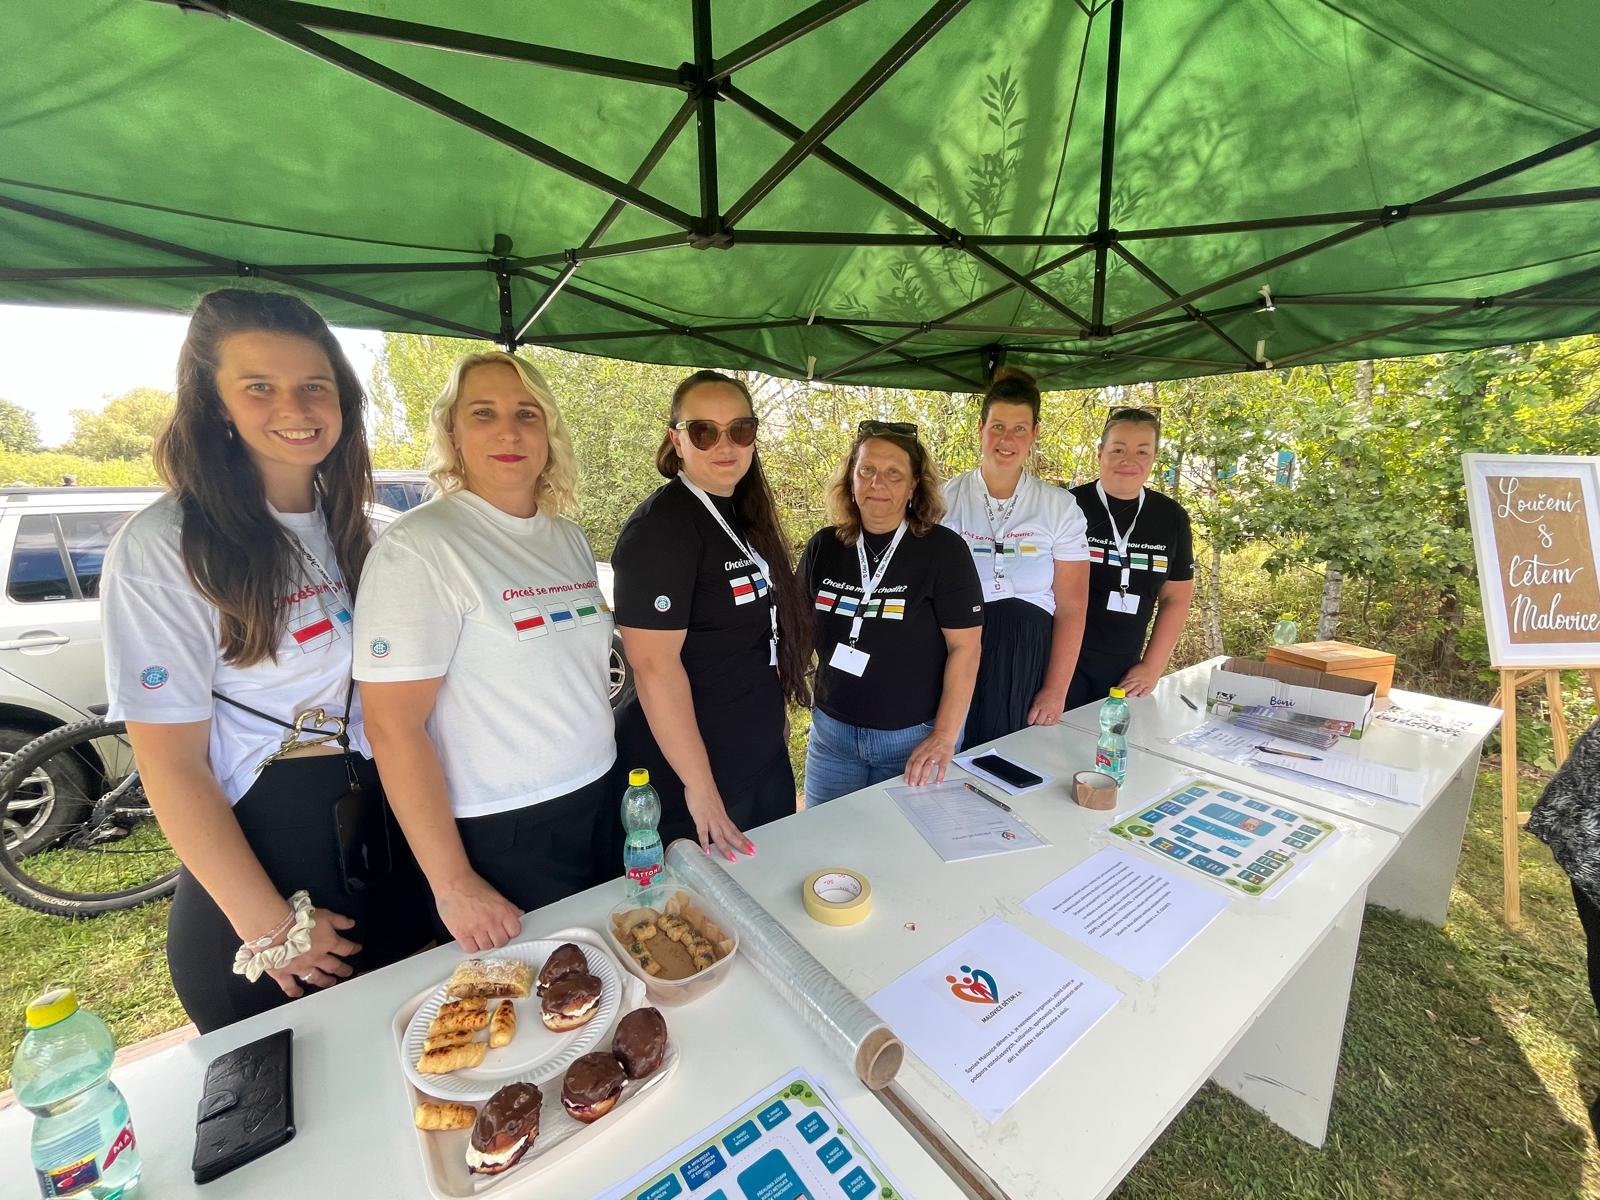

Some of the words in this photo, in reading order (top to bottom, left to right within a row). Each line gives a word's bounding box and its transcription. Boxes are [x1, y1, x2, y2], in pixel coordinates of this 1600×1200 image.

[1087, 536, 1108, 546] Chceš
[822, 578, 846, 589] Chceš
[502, 586, 534, 601] Chceš
[536, 586, 548, 595] se
[548, 584, 573, 594] mnou
[1511, 592, 1600, 633] Malovice
[981, 1004, 1003, 1024] MALOVICE
[1000, 993, 1016, 1007] DĚTEM
